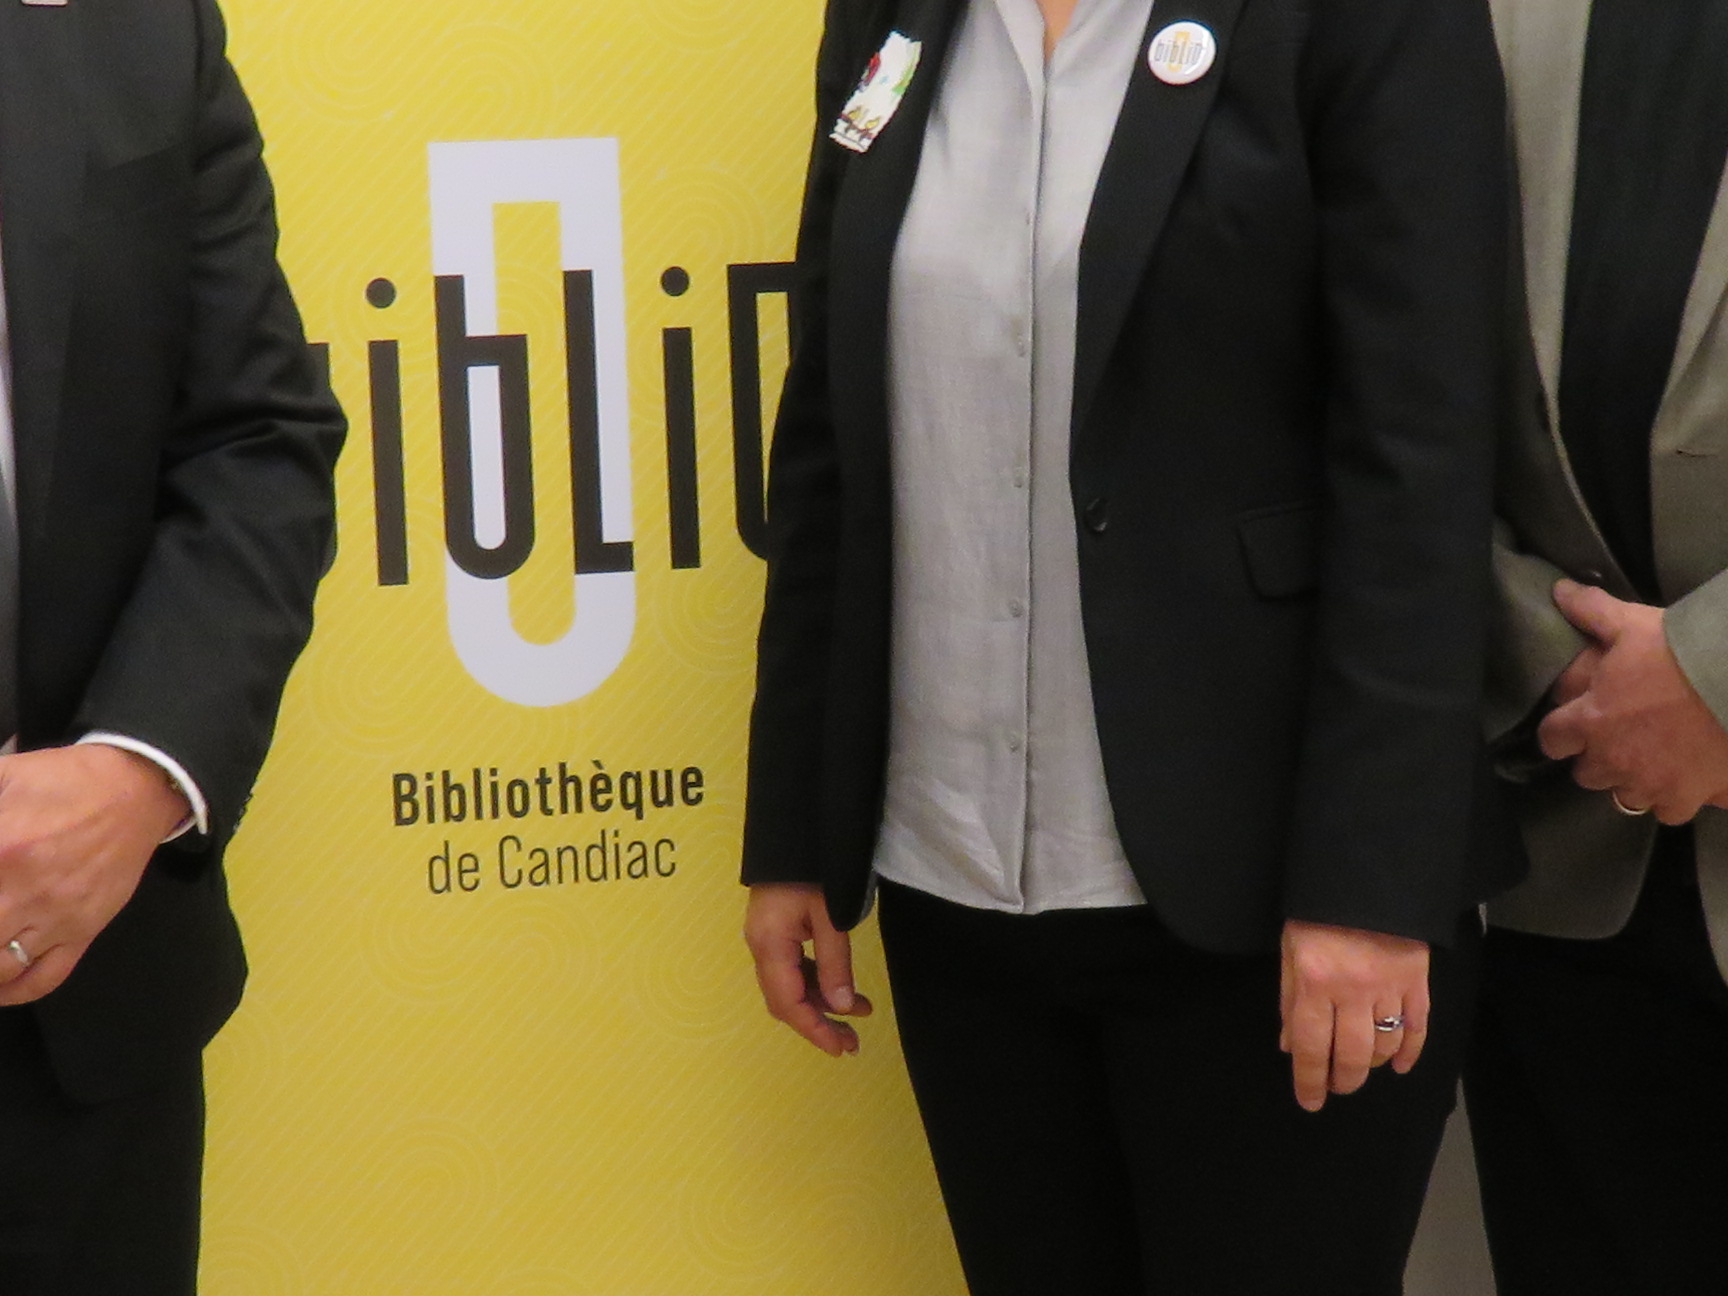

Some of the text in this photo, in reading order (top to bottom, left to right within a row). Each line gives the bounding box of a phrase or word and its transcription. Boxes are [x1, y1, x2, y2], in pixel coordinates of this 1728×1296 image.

[392, 759, 705, 827] Bibliothèque
[428, 828, 677, 895] de Candiac
